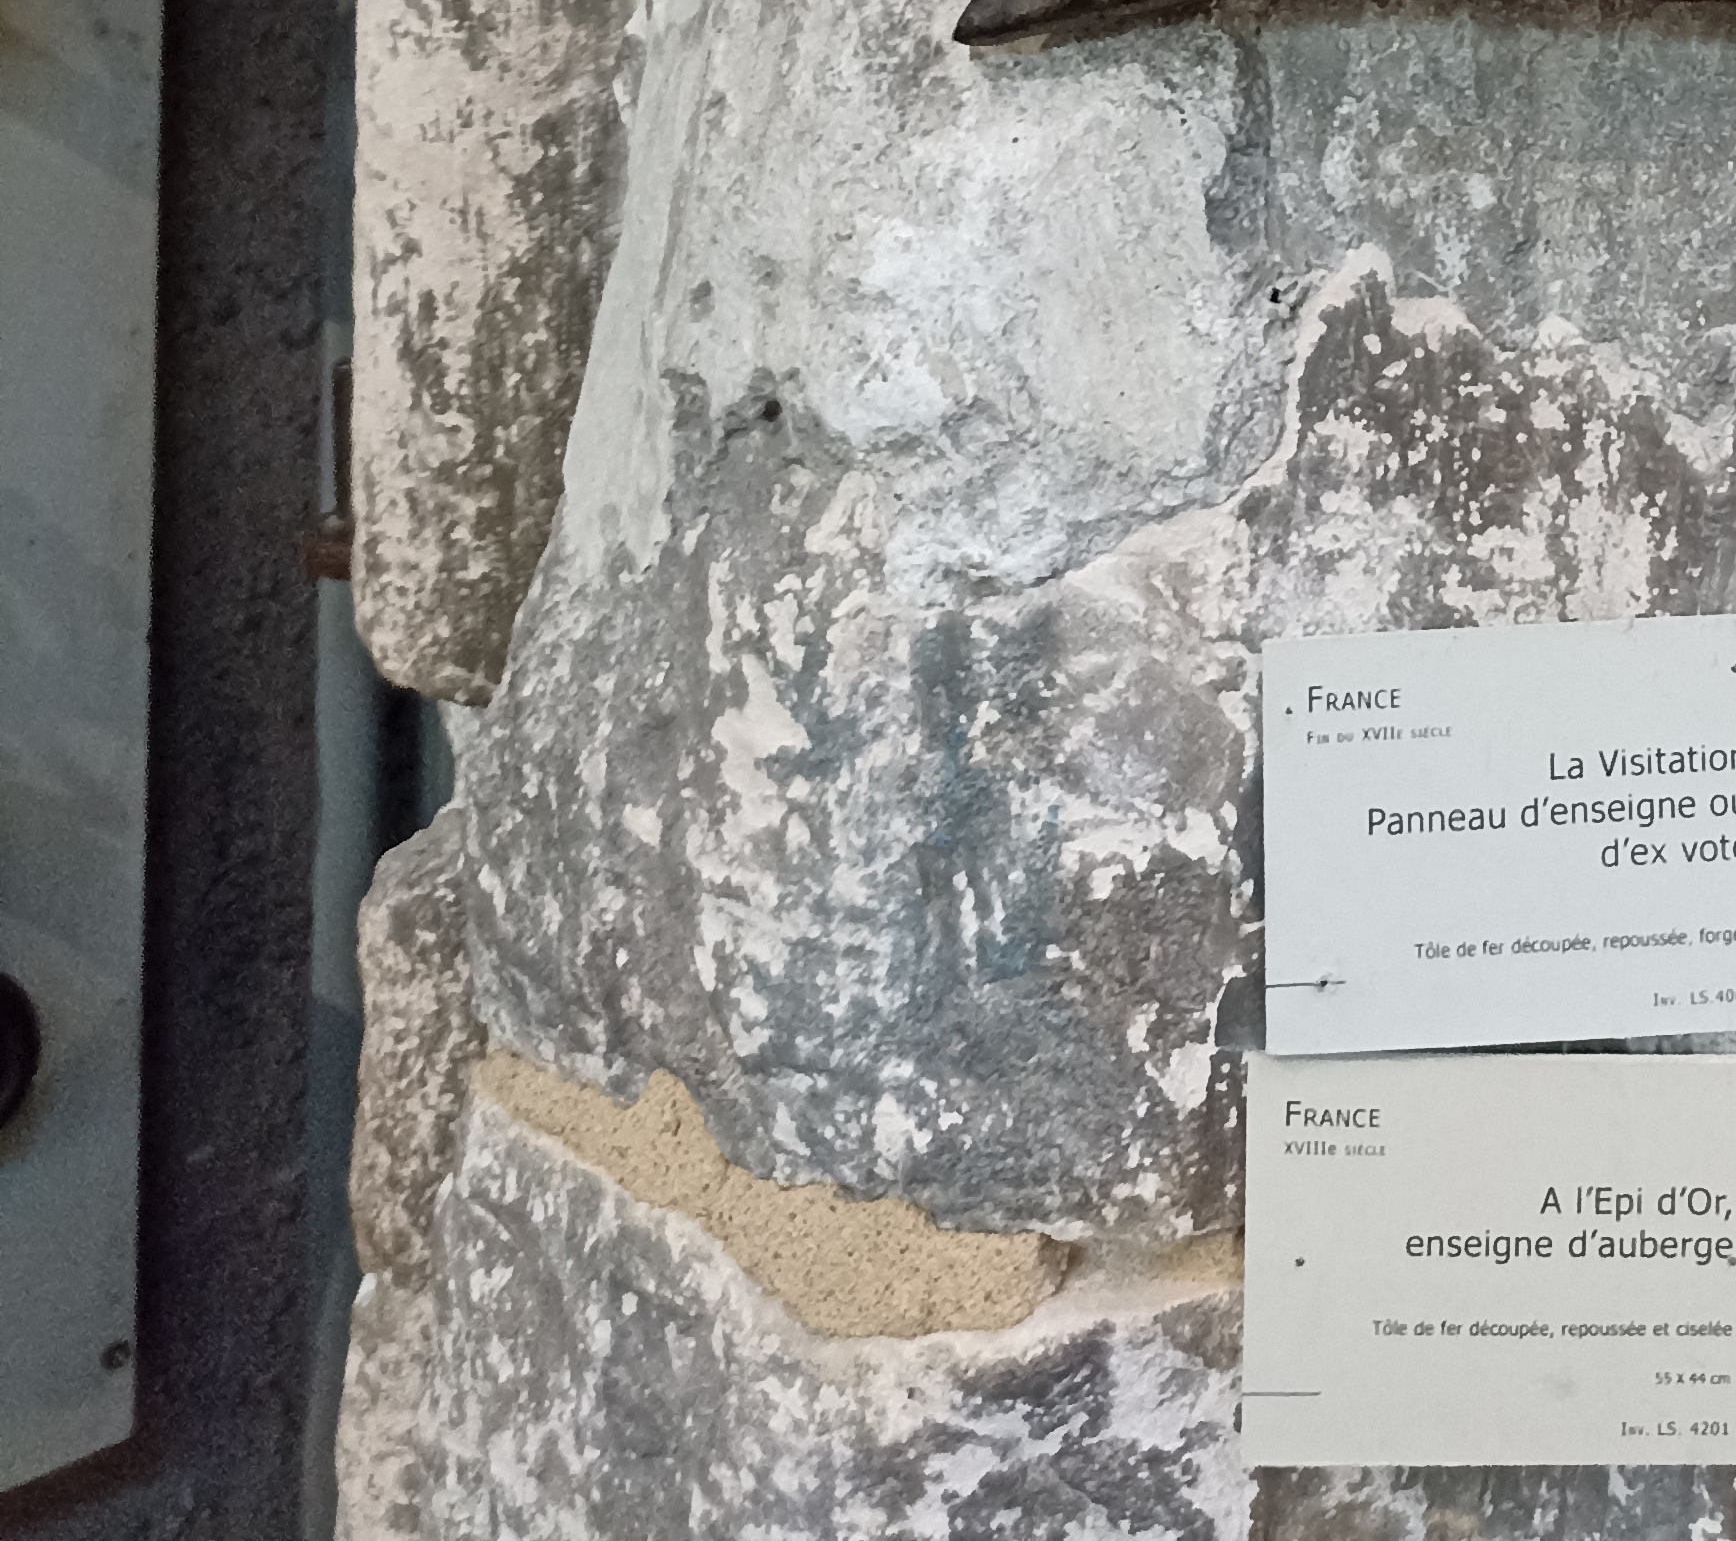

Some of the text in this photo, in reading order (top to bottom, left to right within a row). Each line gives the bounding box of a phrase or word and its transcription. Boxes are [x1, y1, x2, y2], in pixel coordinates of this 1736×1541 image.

[1308, 686, 1402, 713] FRANCE
[1550, 752, 1585, 781] La
[1368, 807, 1507, 837] Panneau
[1521, 793, 1697, 828] d'enseigne
[1601, 836, 1668, 868] d'ex
[1414, 940, 1451, 960] Tôle
[1456, 941, 1477, 958] de
[1482, 939, 1505, 956] fer
[1511, 933, 1597, 955] découpée,
[1602, 928, 1693, 952] repoussée,
[1286, 1100, 1381, 1128] FRANCE
[1540, 1185, 1732, 1223] A l'Epi d'Or,
[1406, 1228, 1734, 1266] enseigne d'auberge
[1373, 1318, 1734, 1340] Tôle de fer découpée, repoussée et ciselée
[1655, 1371, 1673, 1385] 55
[1689, 1372, 1706, 1385] 44
[1710, 1374, 1731, 1385] cm
[1690, 1420, 1729, 1436] 4201
